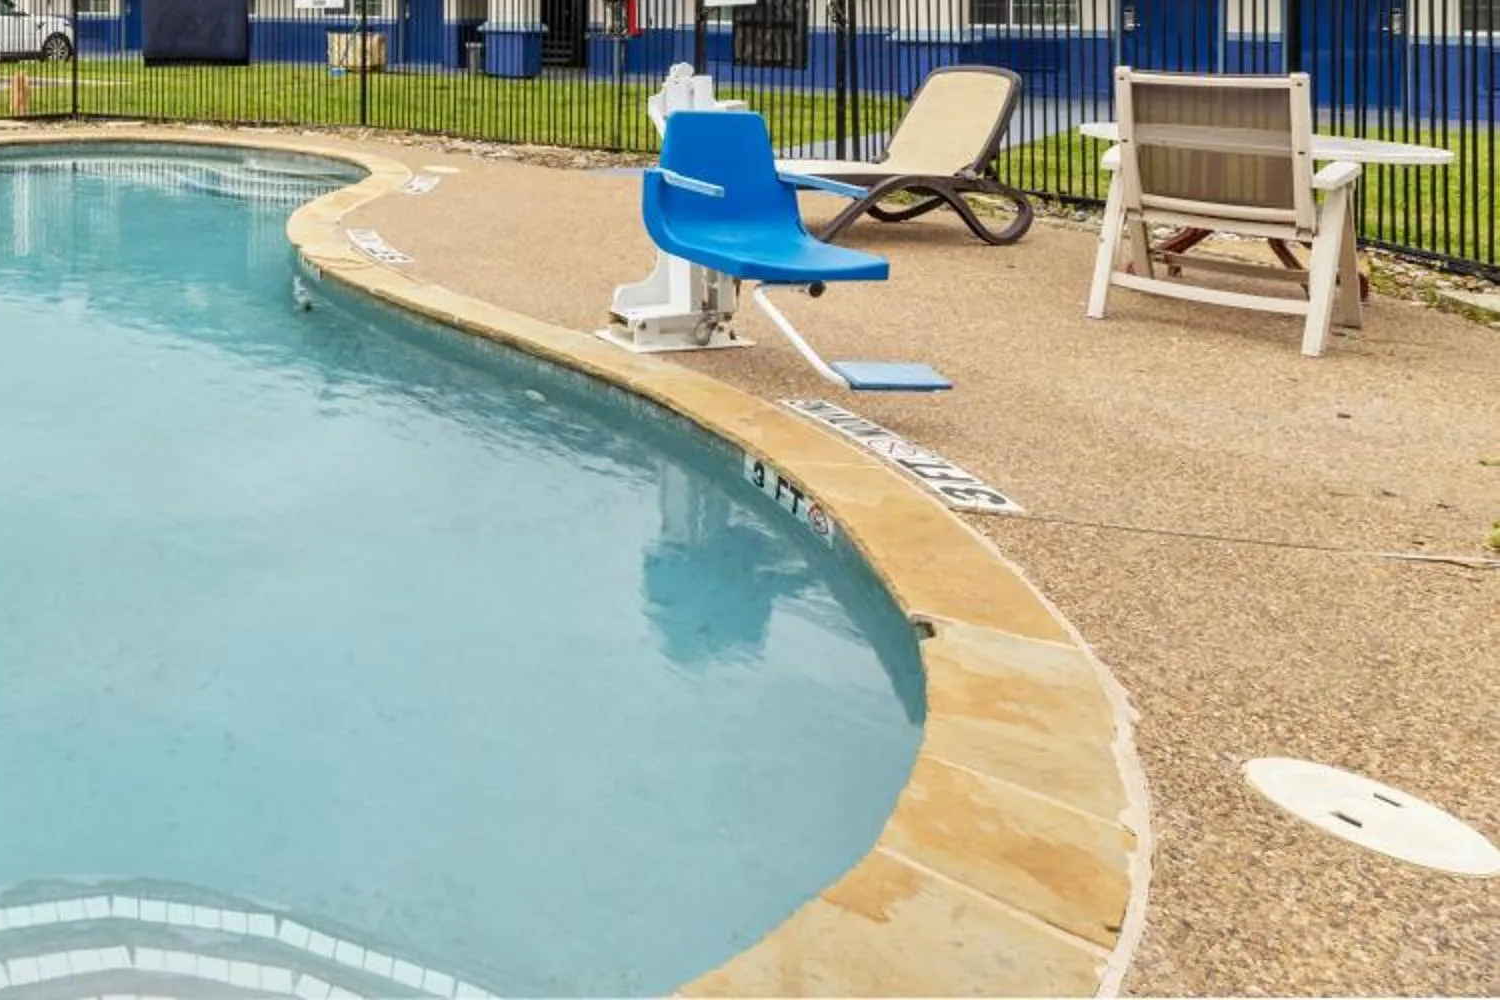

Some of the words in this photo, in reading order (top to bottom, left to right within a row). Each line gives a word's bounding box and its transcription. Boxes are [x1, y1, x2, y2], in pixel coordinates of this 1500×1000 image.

[895, 457, 977, 483] FT
[751, 460, 766, 489] 3
[774, 476, 805, 515] FT
[937, 484, 1007, 505] 3
